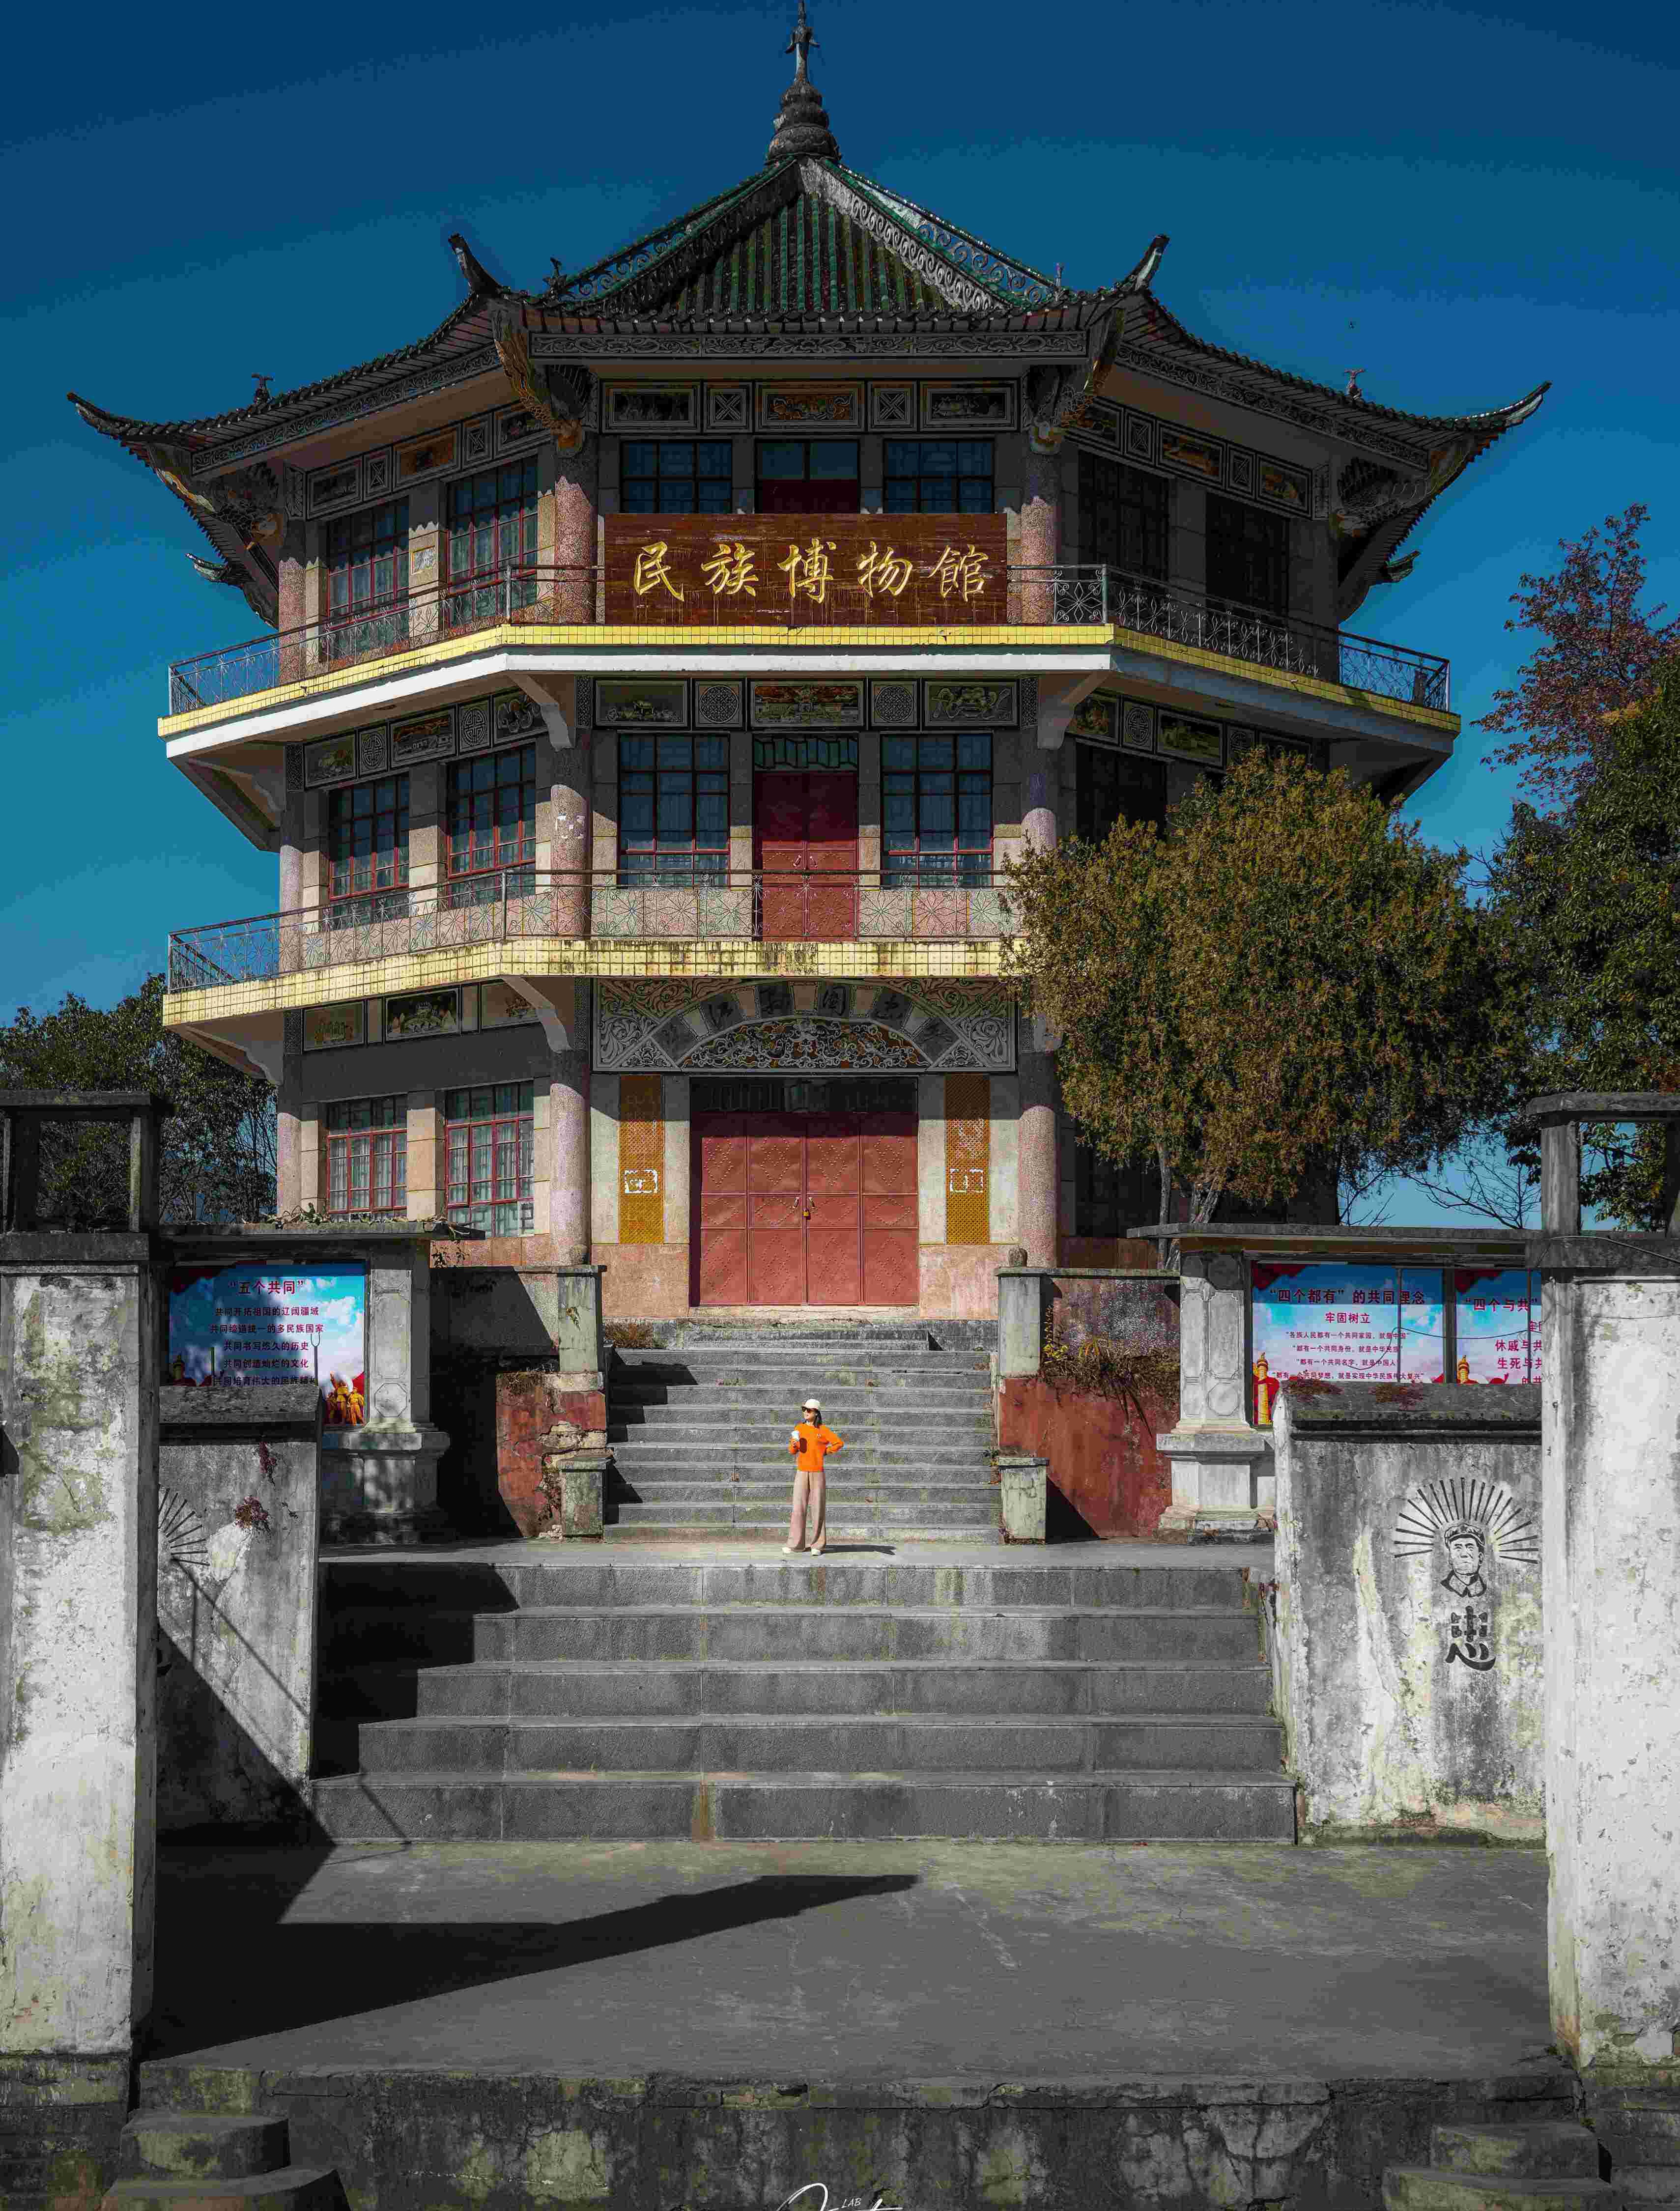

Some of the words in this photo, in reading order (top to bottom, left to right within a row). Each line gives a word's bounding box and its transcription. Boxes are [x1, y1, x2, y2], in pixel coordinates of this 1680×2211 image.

[633, 538, 990, 604] 民族博物館
[228, 1280, 304, 1295] “五个共同”
[1466, 1298, 1538, 1311] “四个与共”
[216, 1307, 319, 1316] 共同开拓祖国的辽阔疆域
[1325, 1312, 1370, 1323] 牢固树立
[210, 1324, 324, 1333] 共同缔造统一的多民族国家
[224, 1341, 309, 1351] 共同书写悠久的历史
[224, 1359, 309, 1368] 共同创造灿烂的文化
